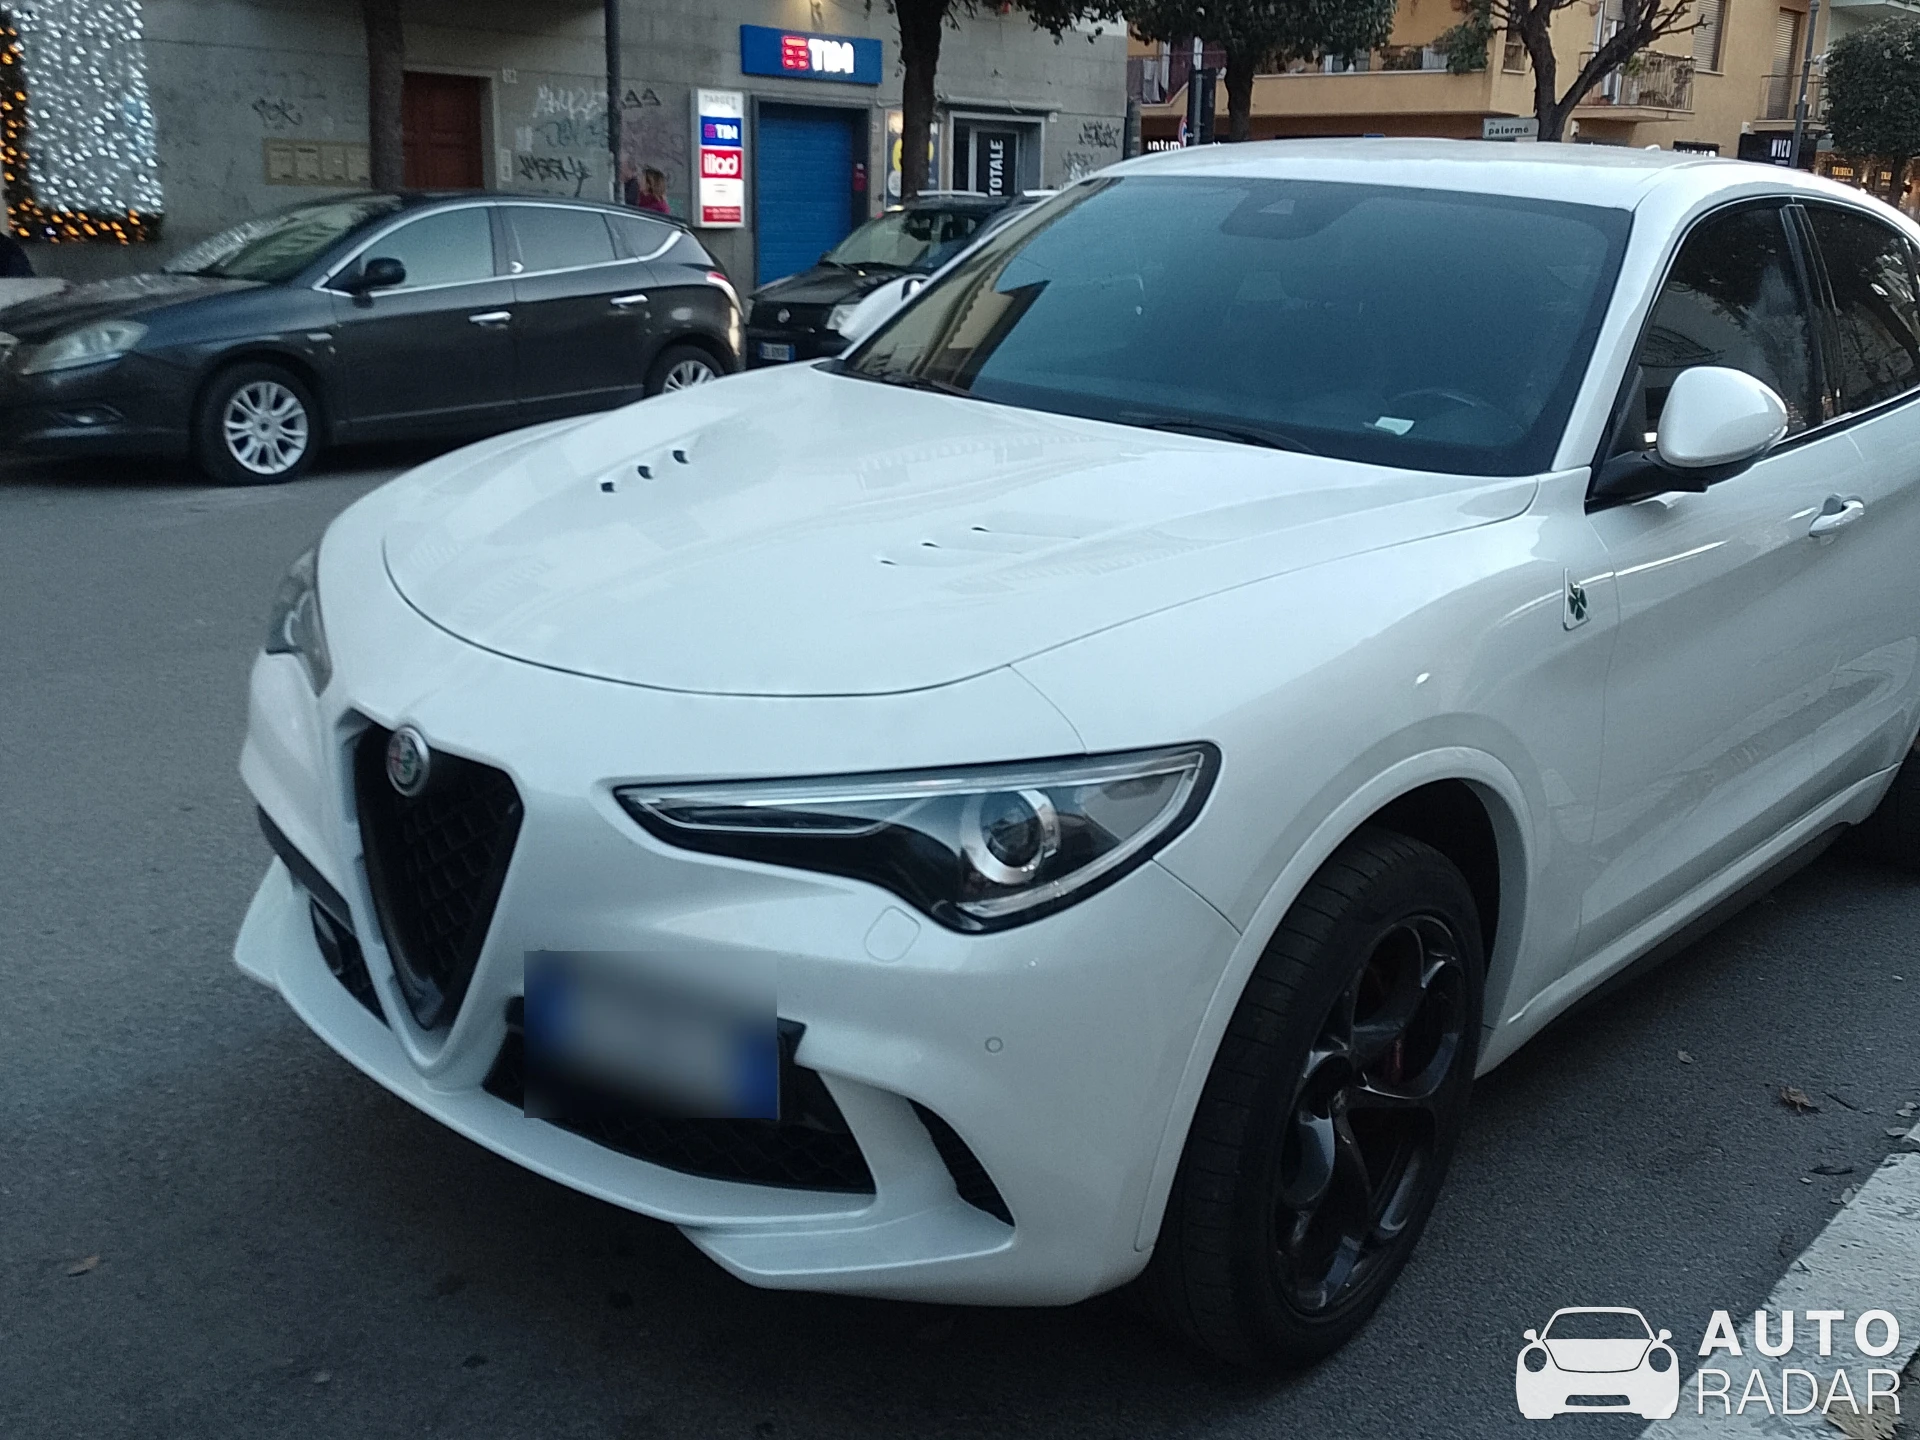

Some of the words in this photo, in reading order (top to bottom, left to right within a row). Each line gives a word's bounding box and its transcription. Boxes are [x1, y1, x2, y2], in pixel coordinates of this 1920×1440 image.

[808, 38, 855, 74] TIM
[1488, 125, 1530, 136] palermo
[1771, 139, 1792, 158] WYCO
[703, 153, 739, 176] iliad
[989, 139, 1004, 197] TOTALE
